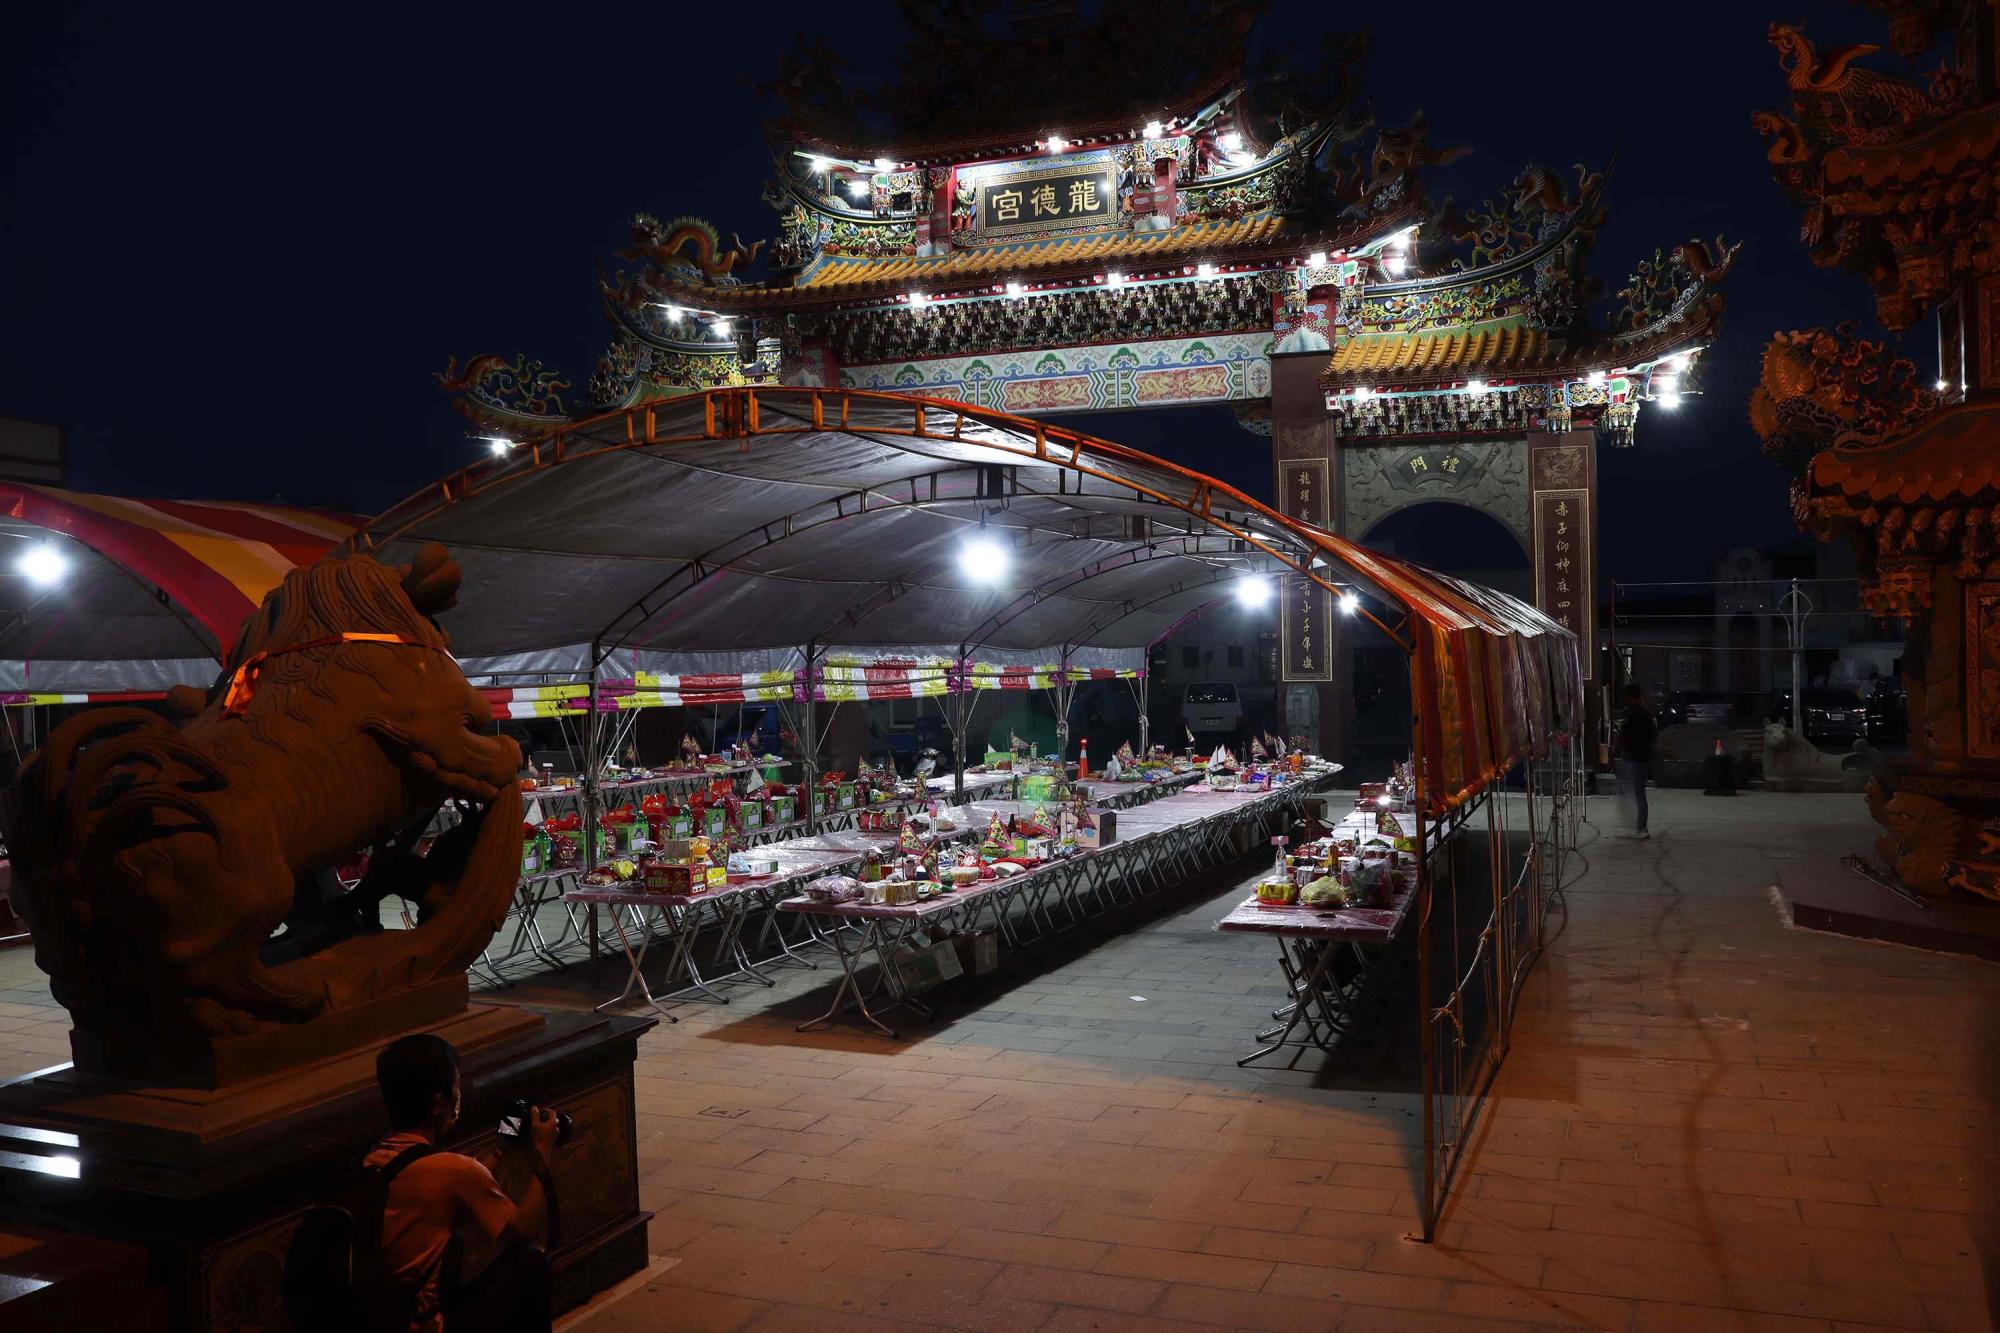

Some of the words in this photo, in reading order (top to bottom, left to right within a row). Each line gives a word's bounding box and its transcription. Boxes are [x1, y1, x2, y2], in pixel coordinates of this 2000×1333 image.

[992, 179, 1100, 221] 龍德宮
[1409, 455, 1460, 474] 禮門
